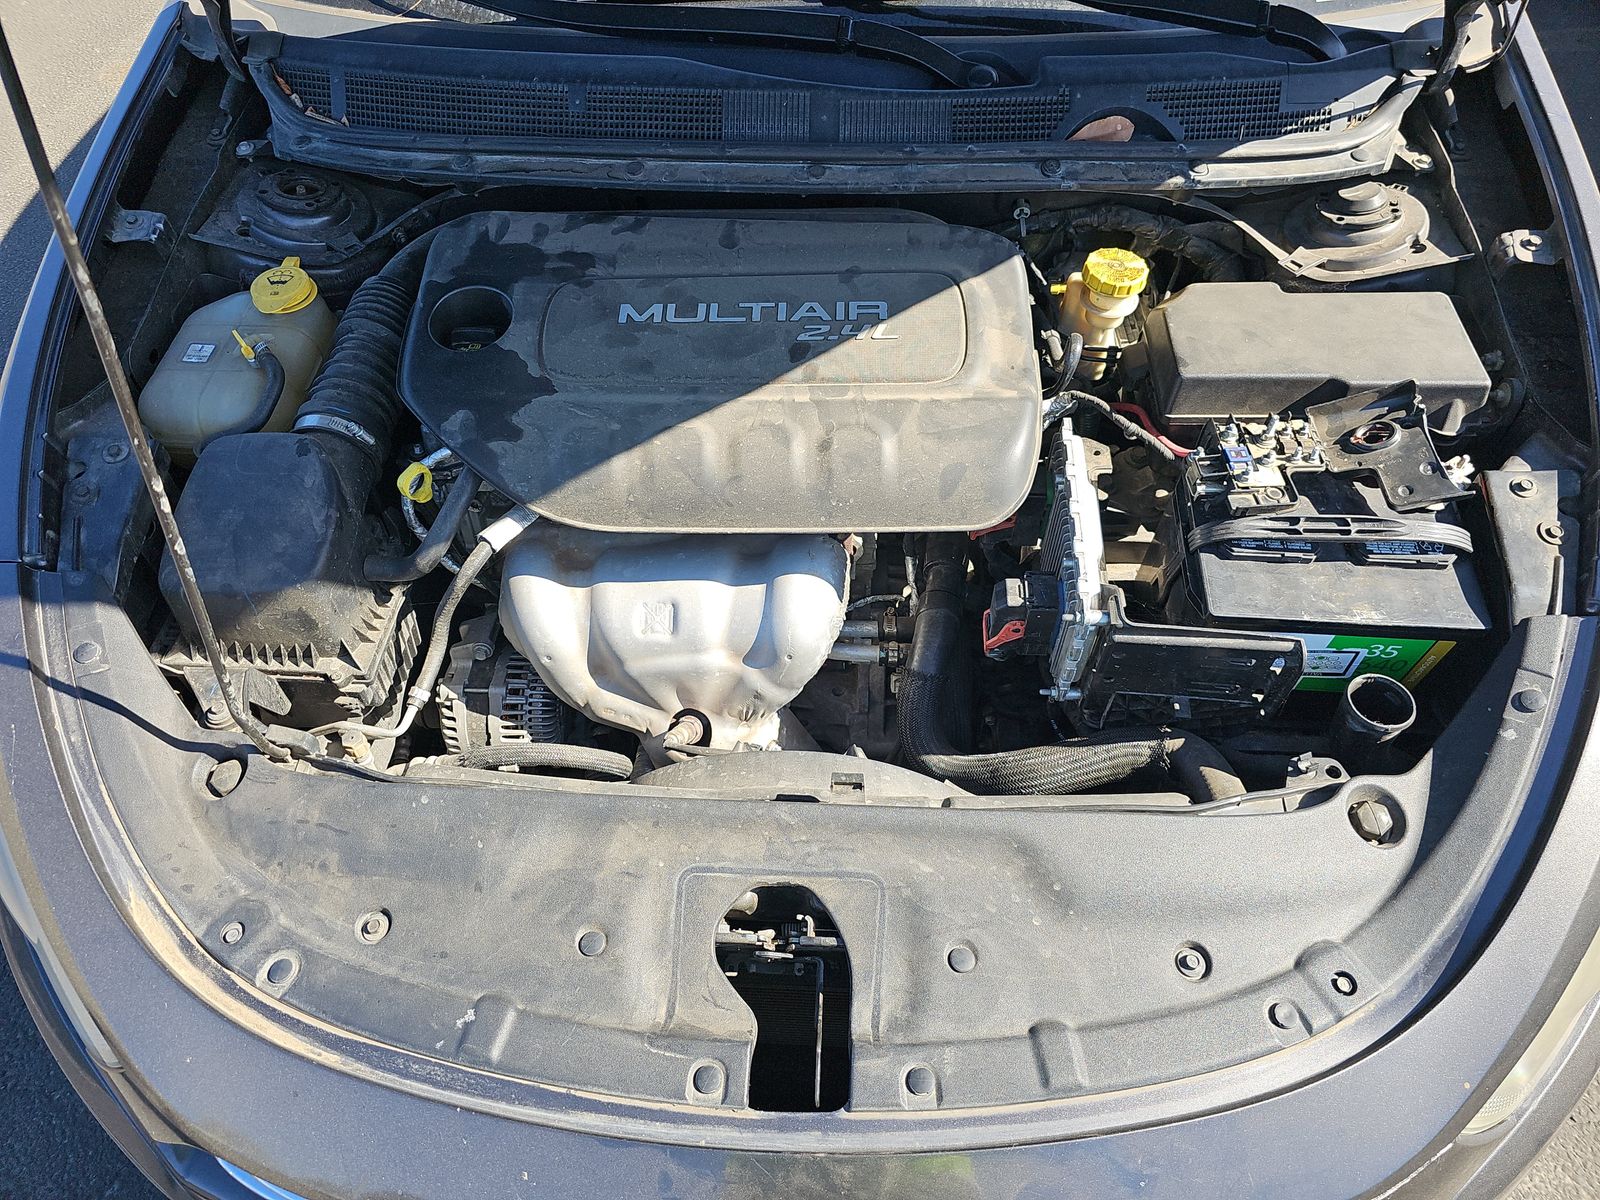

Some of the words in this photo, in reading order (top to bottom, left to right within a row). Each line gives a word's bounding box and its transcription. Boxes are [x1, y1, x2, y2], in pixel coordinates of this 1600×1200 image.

[618, 301, 888, 323] MULTIAIR
[796, 323, 900, 341] 2.4L
[1365, 644, 1402, 658] 35
